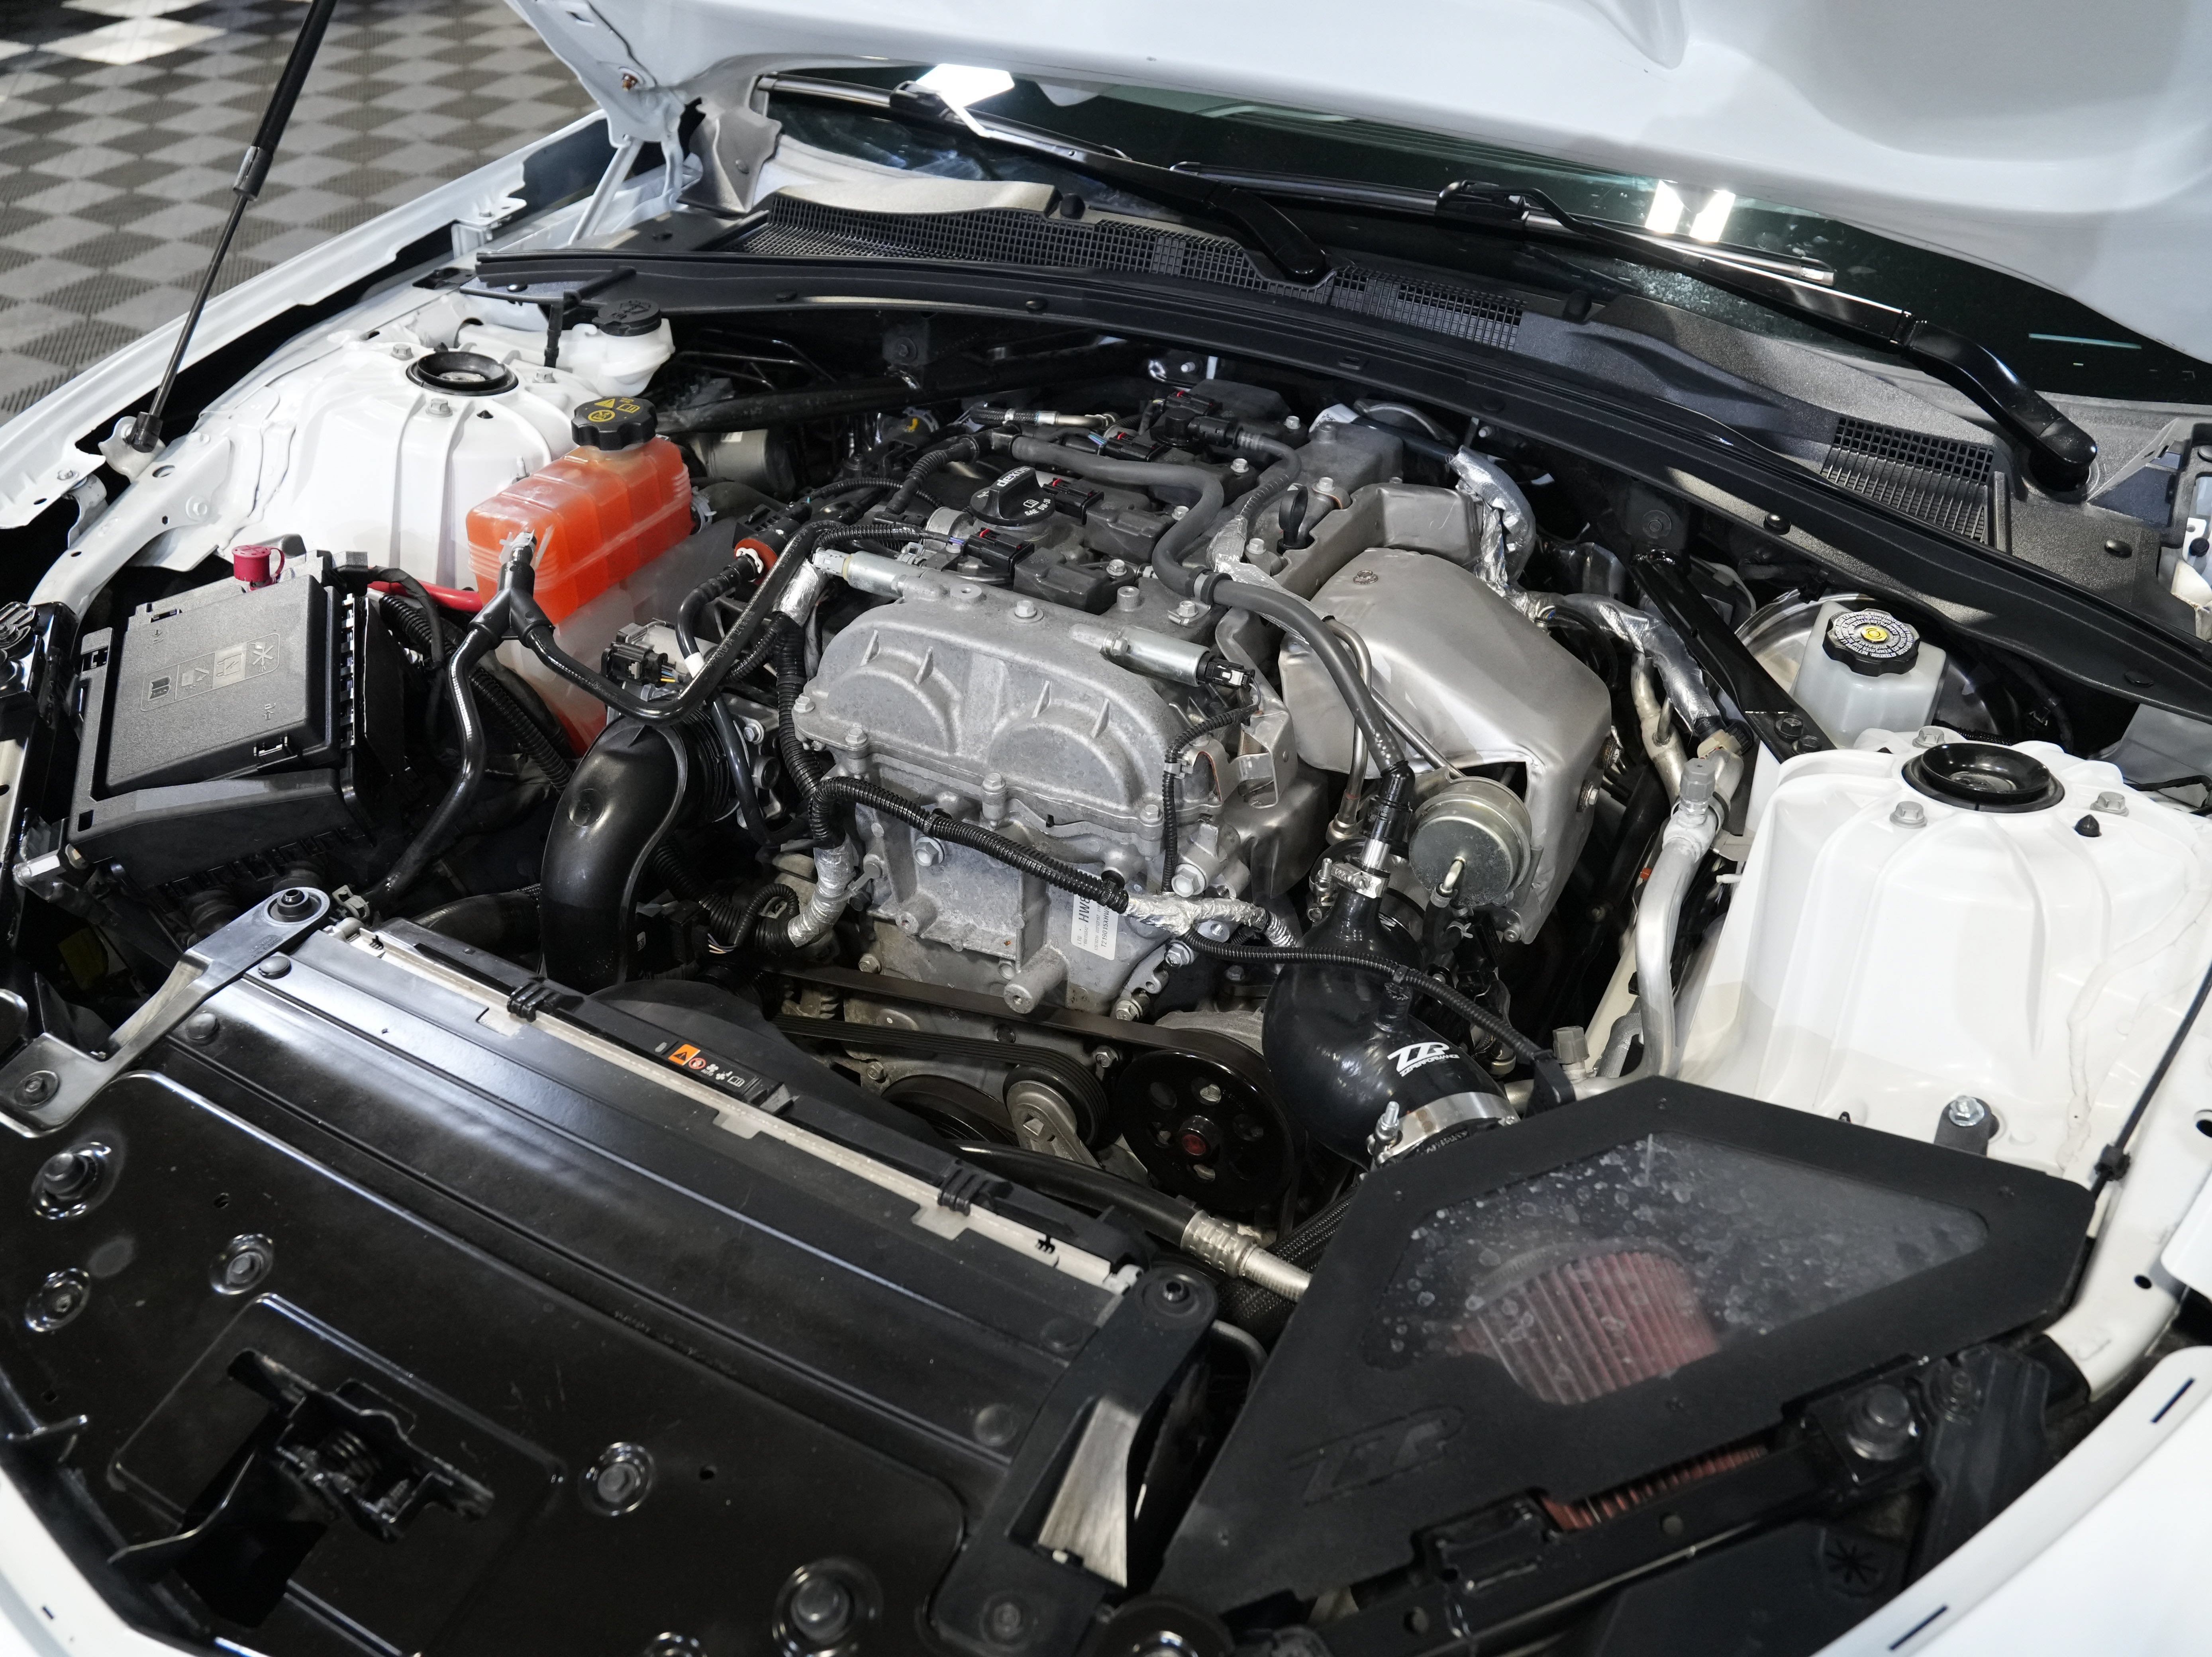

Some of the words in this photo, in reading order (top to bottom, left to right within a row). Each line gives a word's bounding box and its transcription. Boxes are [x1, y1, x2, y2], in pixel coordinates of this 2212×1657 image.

[997, 466, 1030, 487] dexos
[1037, 498, 1051, 511] 5W-30
[1886, 625, 1898, 635] CLEAN
[1845, 642, 1868, 655] NETTOYER
[1858, 640, 1888, 649] PROVENANT
[1387, 1042, 1450, 1072] ZZP
[700, 1068, 714, 1077] AUTO
